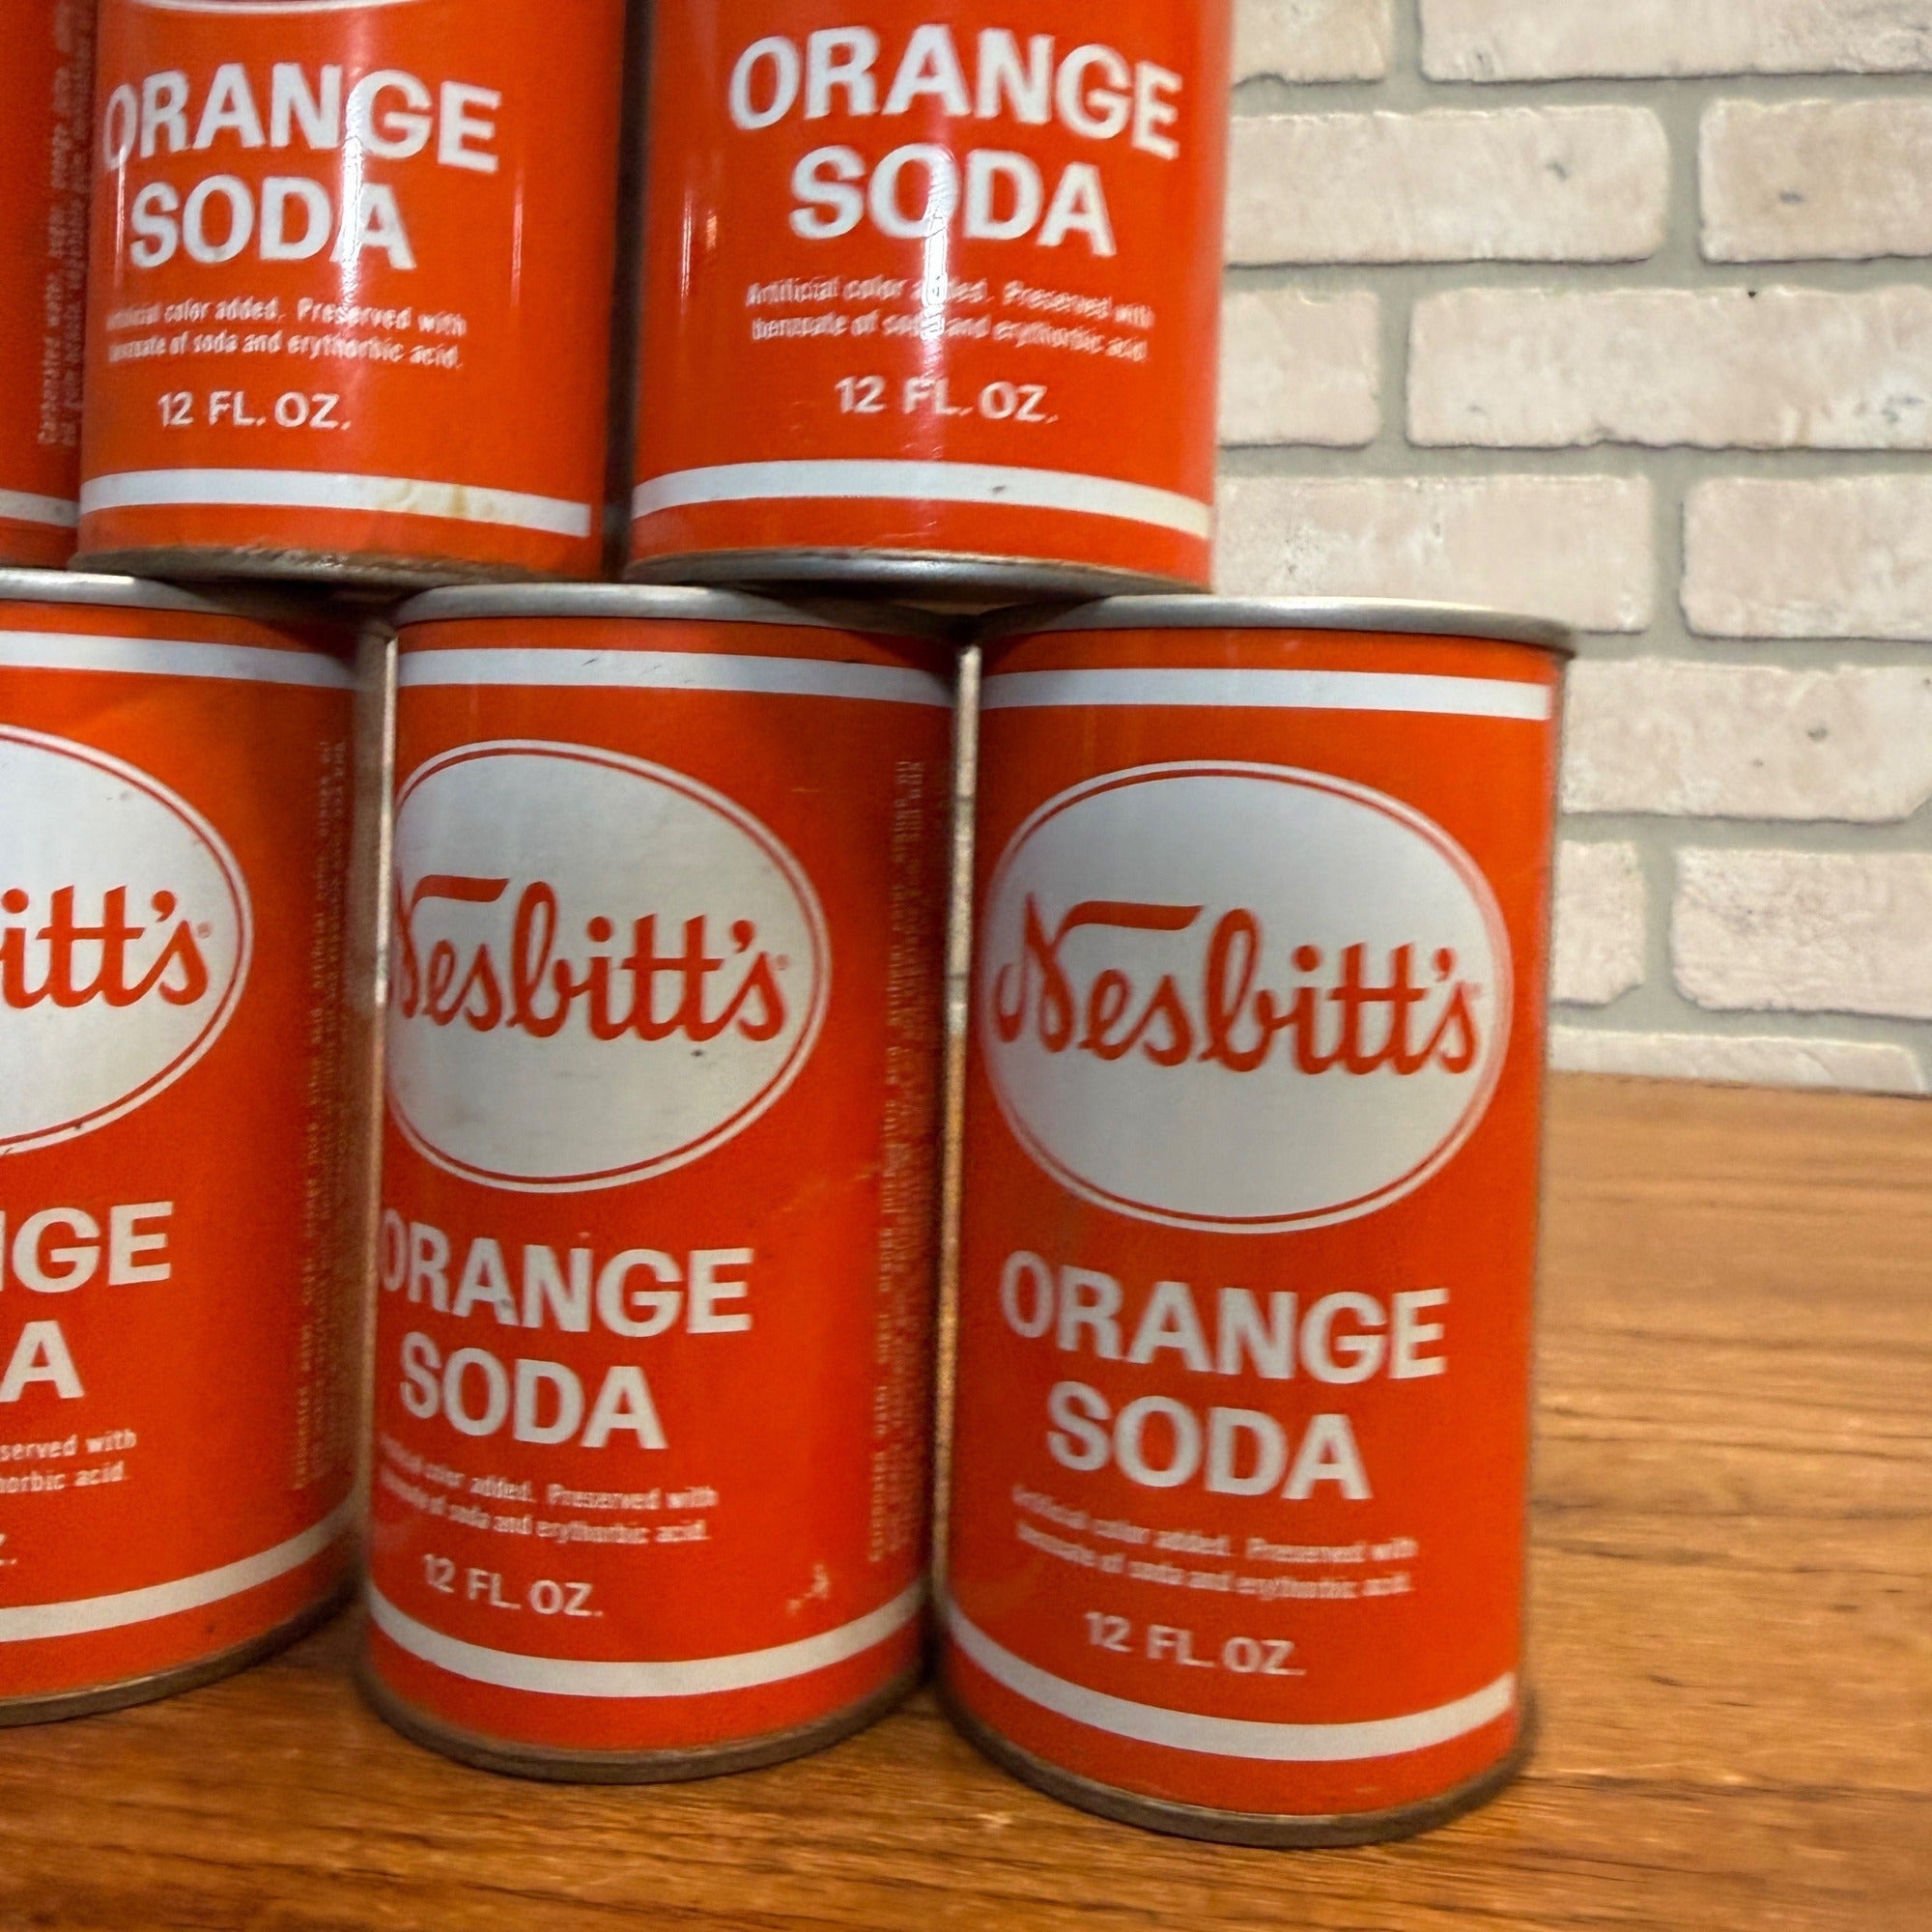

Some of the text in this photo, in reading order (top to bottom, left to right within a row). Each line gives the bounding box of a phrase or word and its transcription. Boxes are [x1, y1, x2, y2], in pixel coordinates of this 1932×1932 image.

[103, 63, 501, 173] ORANGE
[728, 24, 1182, 160] ORANGE
[130, 174, 416, 270] SODA
[788, 143, 1118, 258] SODA
[164, 298, 212, 323] color
[297, 298, 412, 329] Preserved
[417, 311, 467, 336] with
[169, 330, 189, 355] of
[193, 329, 239, 354] soda
[242, 329, 283, 354] and
[157, 391, 193, 427] 12
[835, 375, 887, 413] 12
[0, 885, 208, 1009] itt's
[993, 891, 1476, 1076] Nesbitt's
[381, 1208, 754, 1338] ORANGE
[1000, 1250, 1449, 1384] ORANGE
[85, 1429, 137, 1454] with
[400, 1331, 668, 1450] SODA
[1046, 1380, 1374, 1501] SODA
[423, 1553, 455, 1594] 12
[1085, 1611, 1134, 1653] 12
